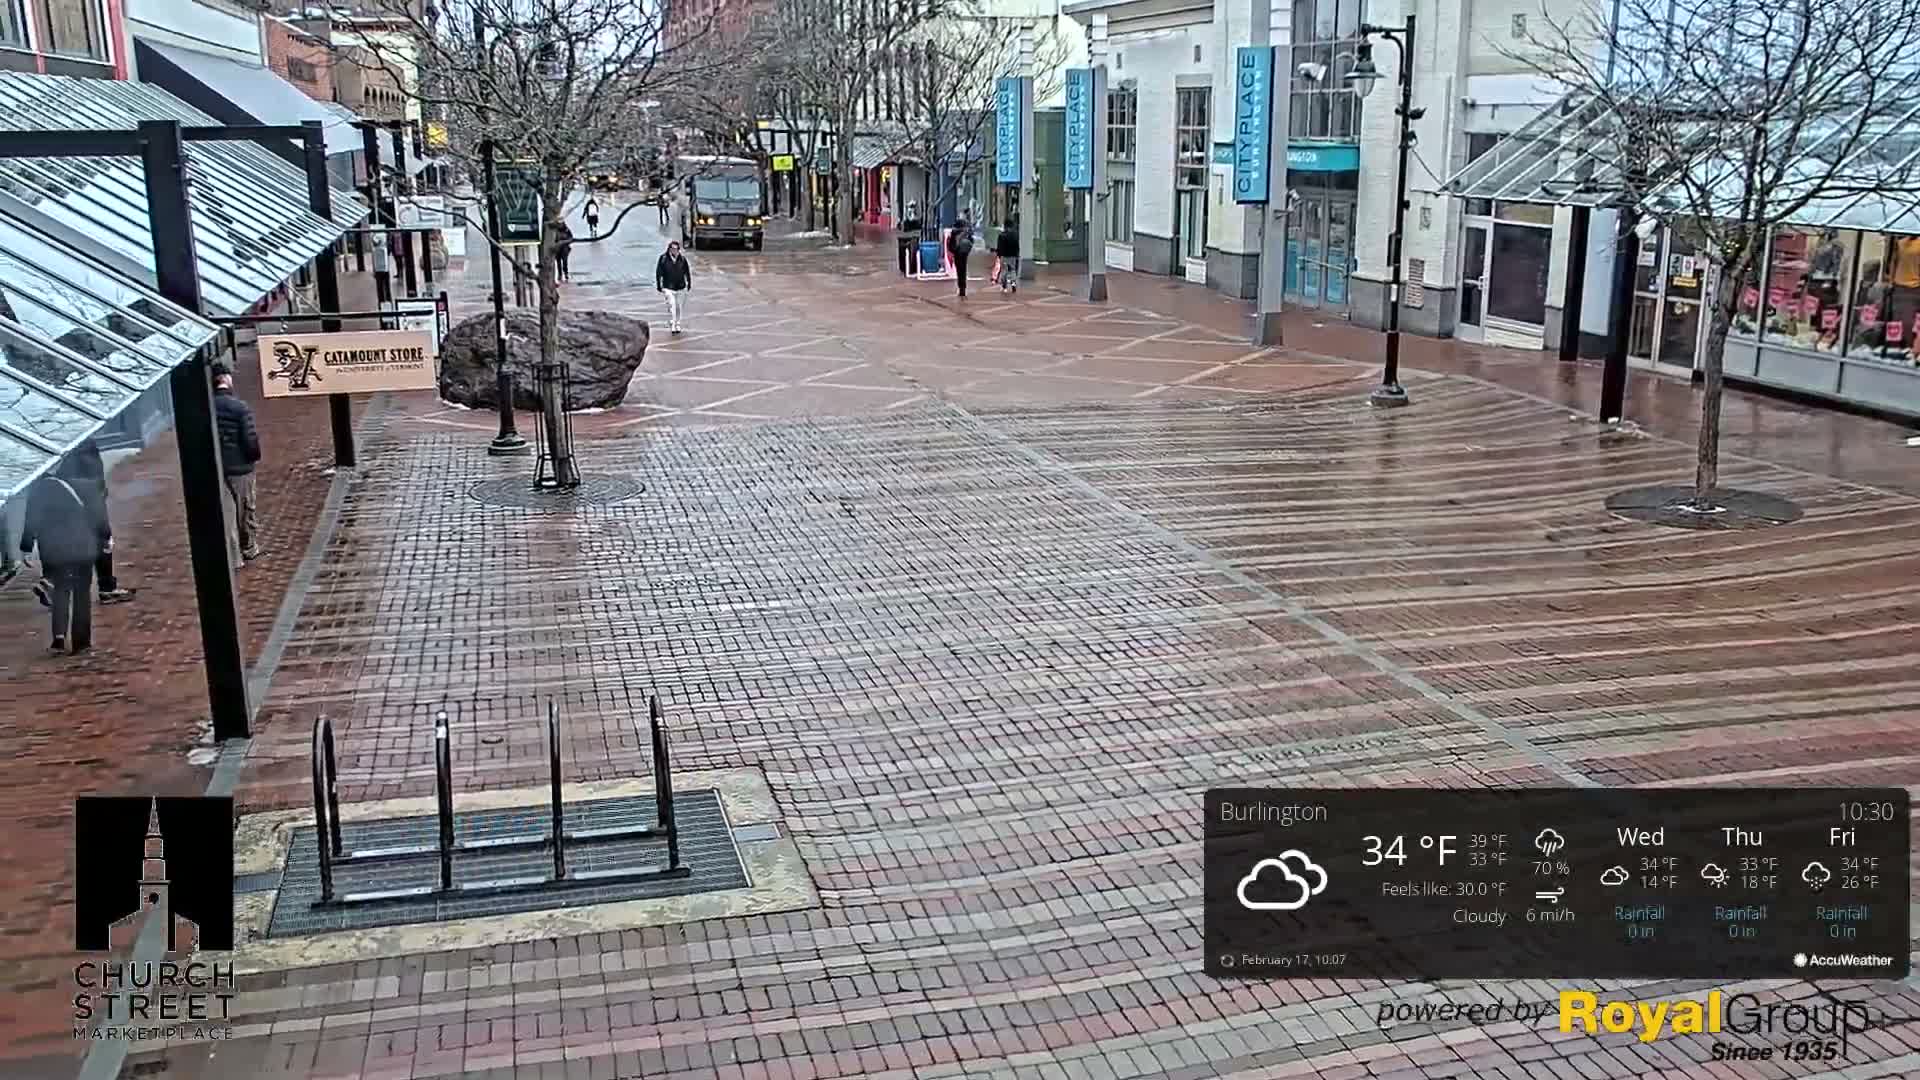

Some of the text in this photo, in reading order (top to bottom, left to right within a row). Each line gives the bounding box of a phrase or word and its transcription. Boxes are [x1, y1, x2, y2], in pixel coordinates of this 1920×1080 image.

[998, 80, 1010, 177] CITYPLACE
[1068, 72, 1080, 182] CITYPLACE
[1237, 54, 1256, 193] CITYPLACE
[1251, 69, 1263, 179] BURLINGTON
[324, 347, 424, 364] CATAMOUNT STORE
